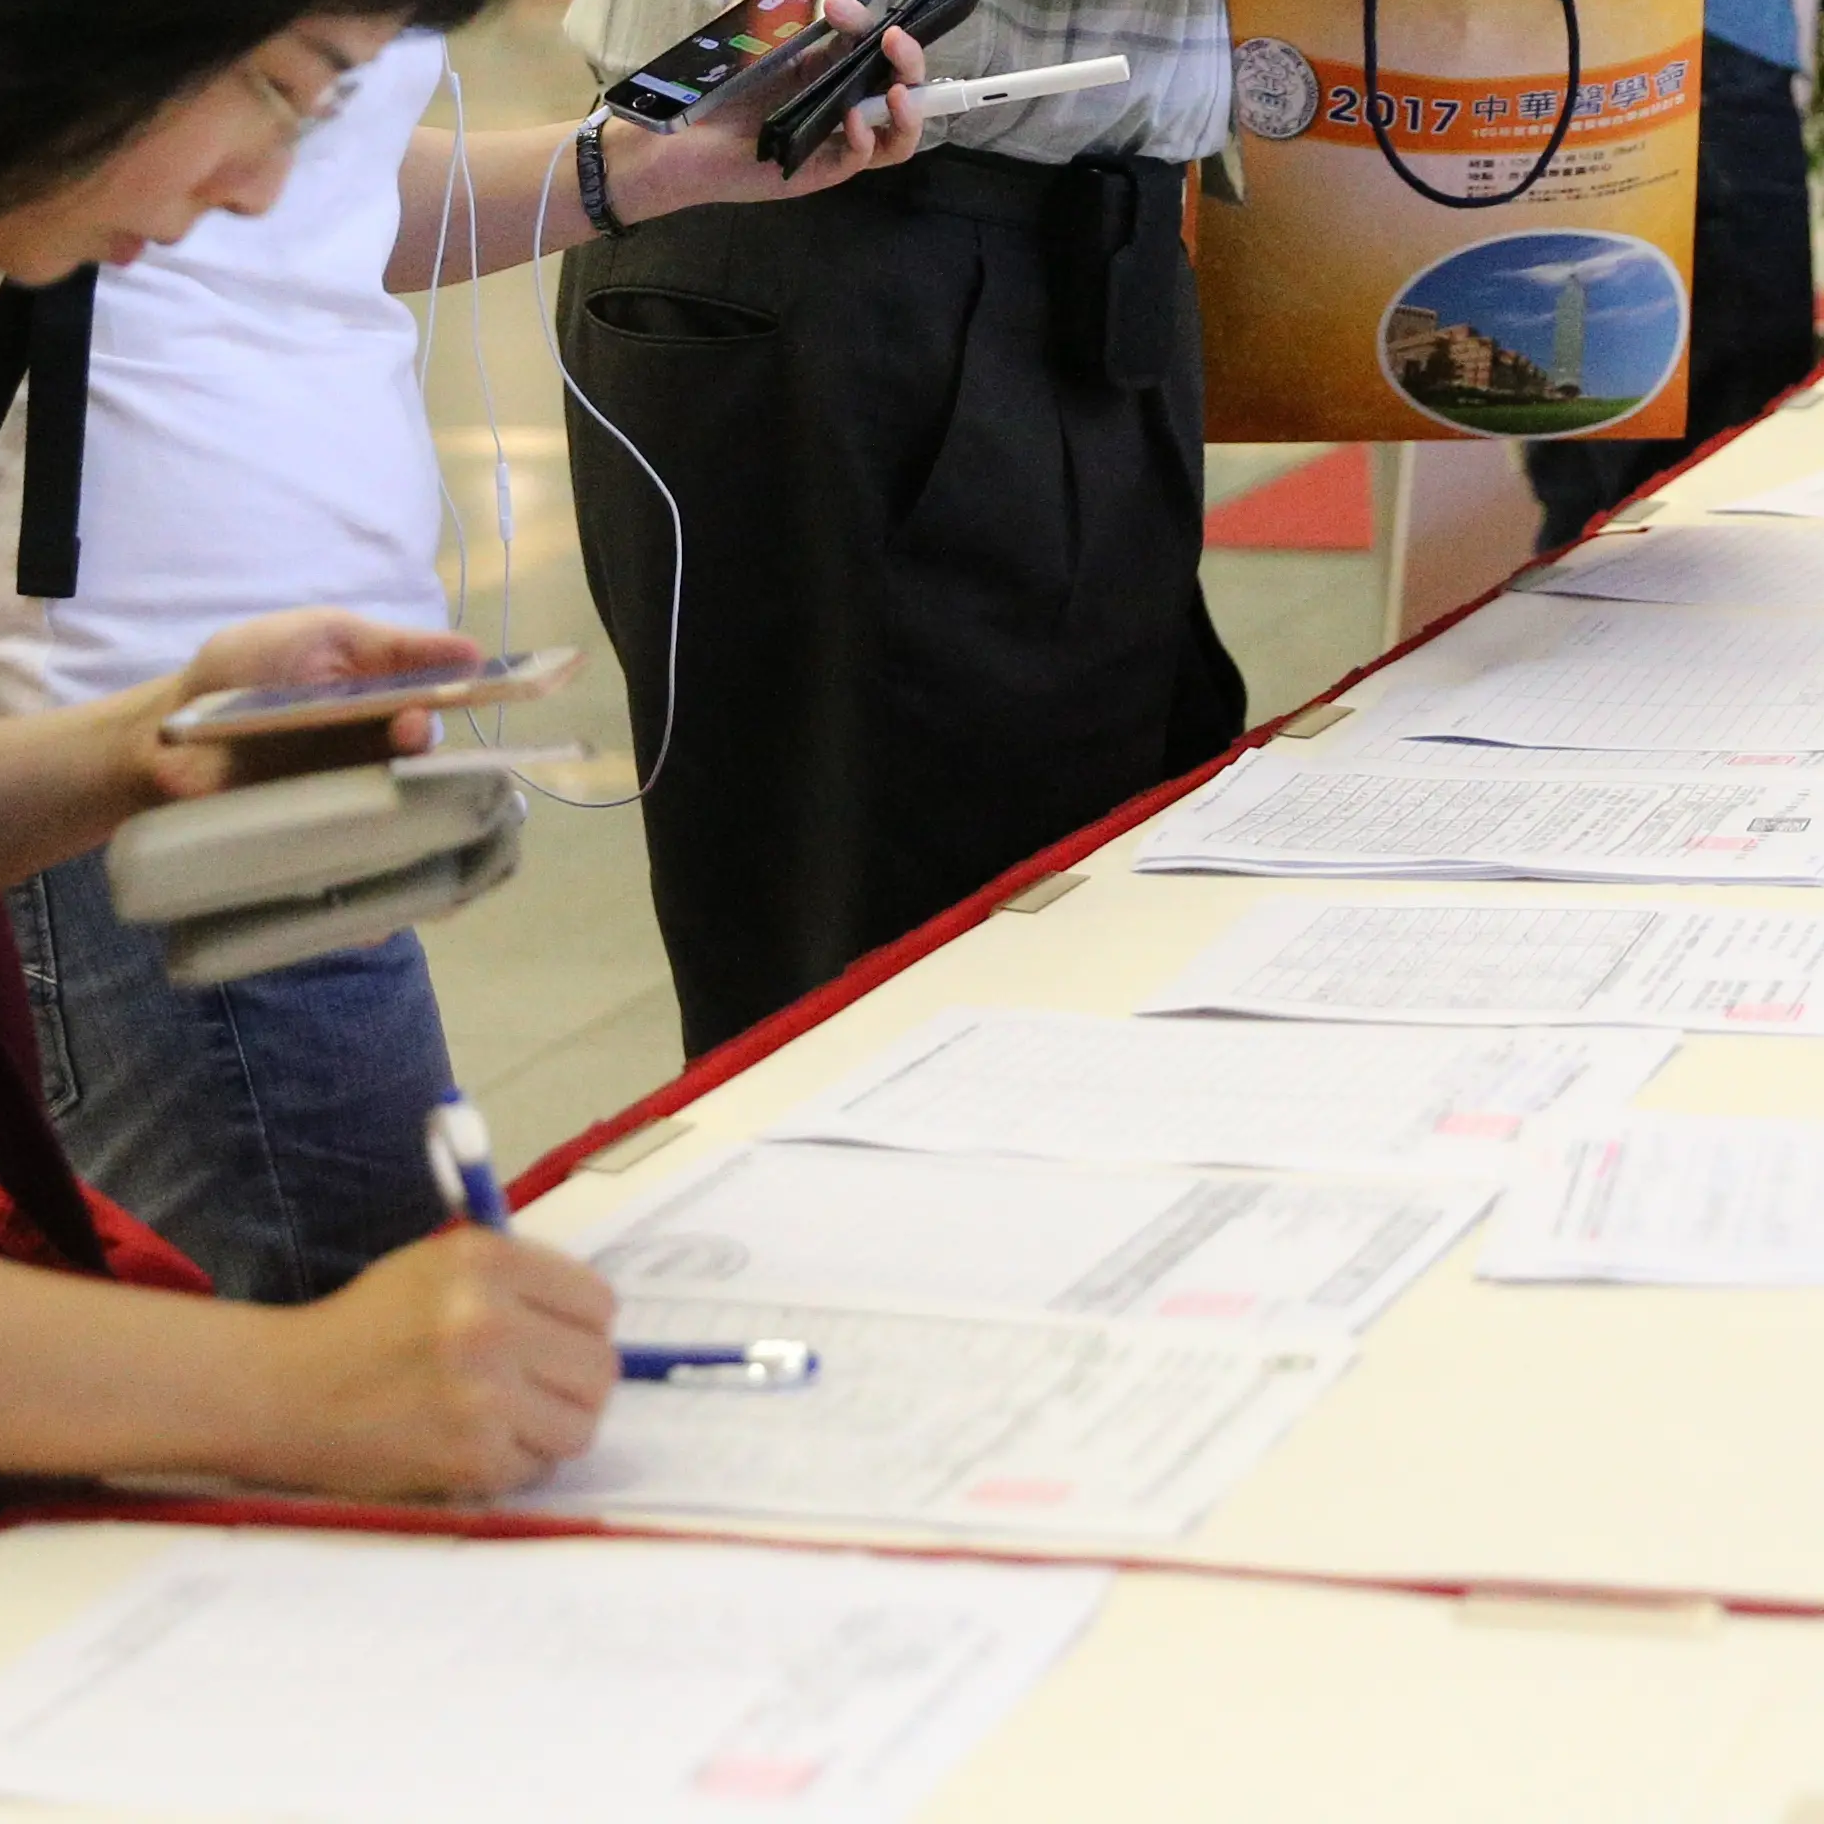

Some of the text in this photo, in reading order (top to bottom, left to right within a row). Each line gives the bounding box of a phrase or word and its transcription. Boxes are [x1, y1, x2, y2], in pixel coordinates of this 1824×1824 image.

[1327, 85, 1461, 134] 2017
[1473, 60, 1689, 123] 中華醫學會
